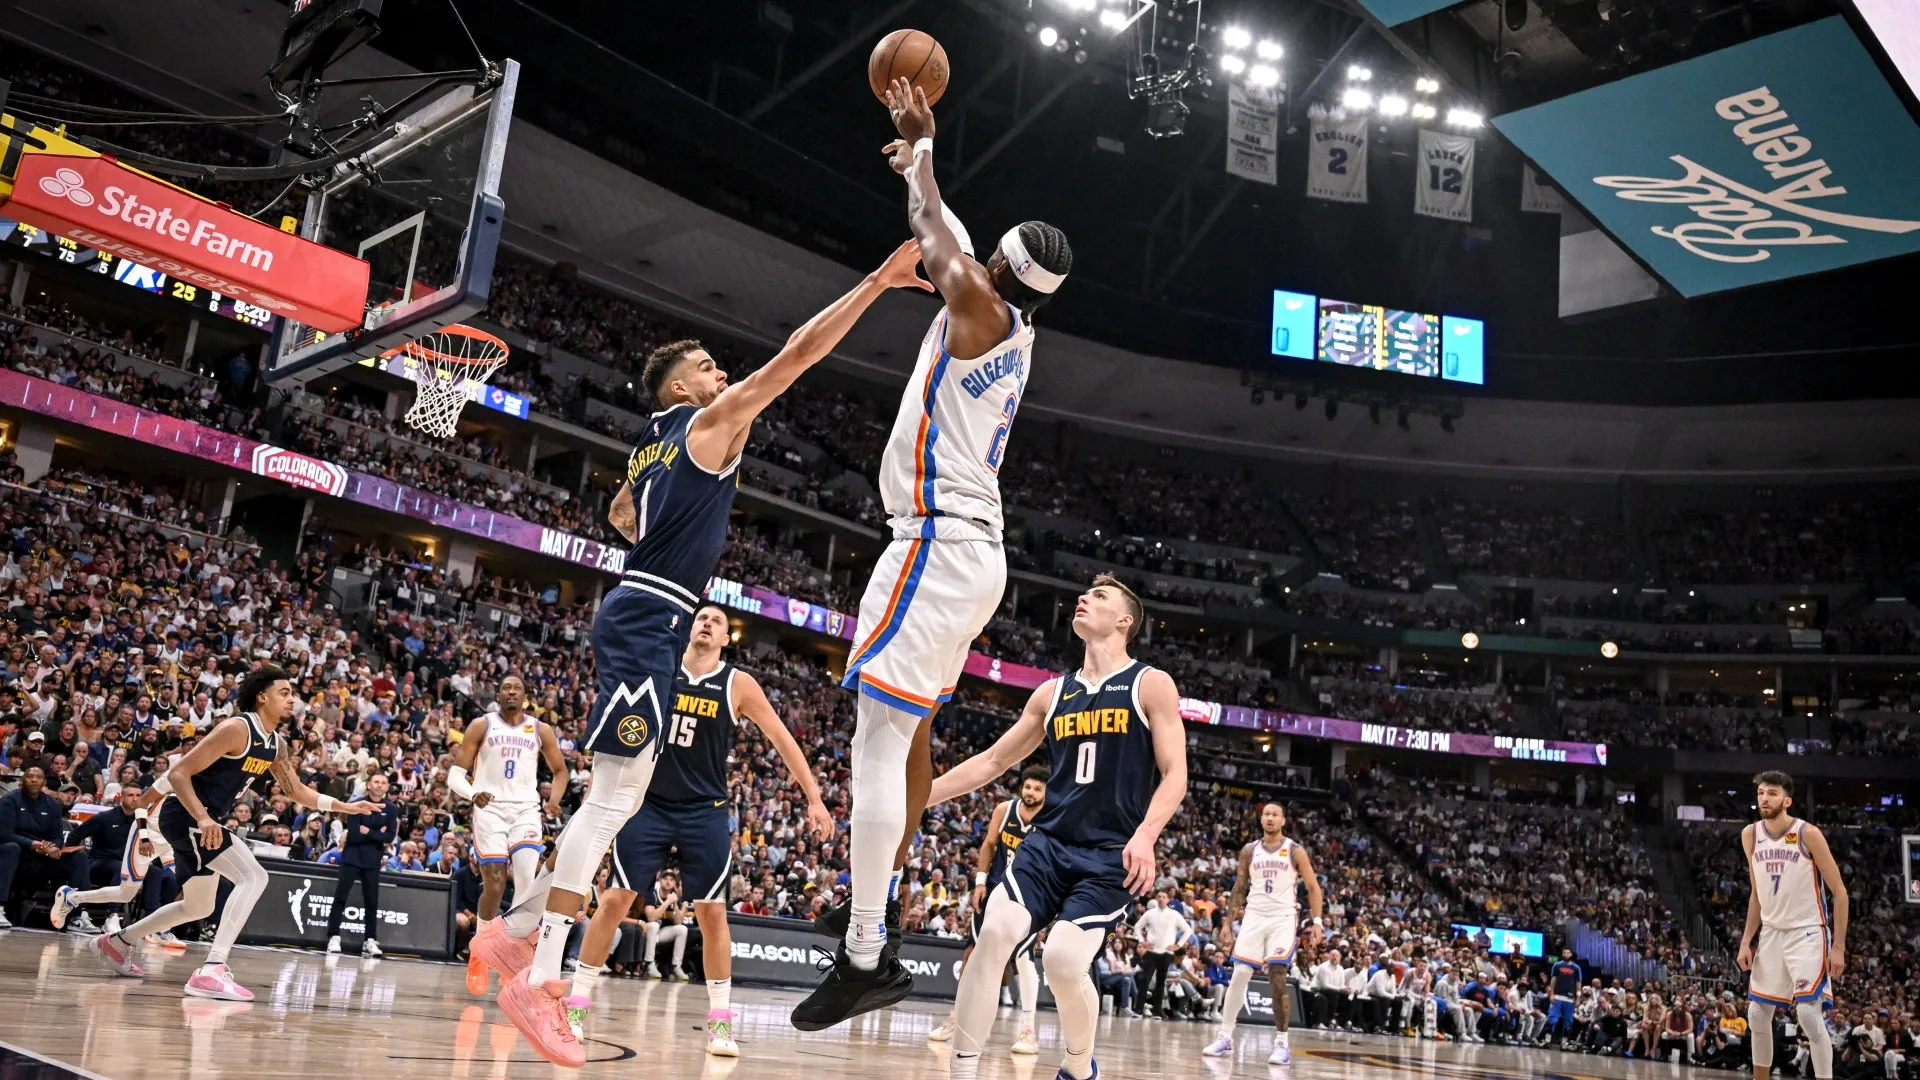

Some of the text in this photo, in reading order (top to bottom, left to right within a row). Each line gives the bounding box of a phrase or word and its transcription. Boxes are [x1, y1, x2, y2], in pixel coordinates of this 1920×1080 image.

[1715, 86, 1848, 200] Arena
[1328, 147, 1348, 175] 2
[1430, 165, 1462, 194] 12
[1593, 155, 1868, 263] Ball
[23, 235, 33, 247] 7
[59, 247, 76, 263] 75
[99, 262, 109, 275] 5
[172, 282, 196, 301] 25
[209, 300, 219, 312] 6
[234, 300, 271, 322] 8:20
[985, 392, 1018, 474] 2
[268, 455, 331, 489] COLORADO
[628, 441, 679, 485] PORTER JR.
[280, 473, 316, 489] RAPIDS
[540, 527, 571, 558] MAY
[571, 537, 587, 562] 17
[595, 543, 625, 574] 7:30
[729, 594, 762, 614] CAUSE
[668, 713, 698, 748] 15
[1054, 708, 1130, 741] DENVER
[487, 735, 536, 750] OKLAHOMA
[1361, 723, 1385, 745] MAY
[1386, 727, 1397, 746] 17
[1406, 729, 1429, 750] 7:30
[1431, 732, 1450, 752] PM
[501, 746, 522, 758] CITY
[1533, 748, 1567, 762] CAUSE
[504, 759, 515, 779] 8
[1075, 741, 1096, 784] 0
[1253, 860, 1289, 871] OKLAHOMA
[1754, 848, 1800, 863] OKLAHOMA
[1262, 870, 1278, 878] CITY
[1765, 861, 1785, 873] CITY
[1265, 879, 1273, 893] 6
[1771, 874, 1781, 895] 7
[308, 894, 335, 904] WNB
[730, 941, 806, 963] SEASON
